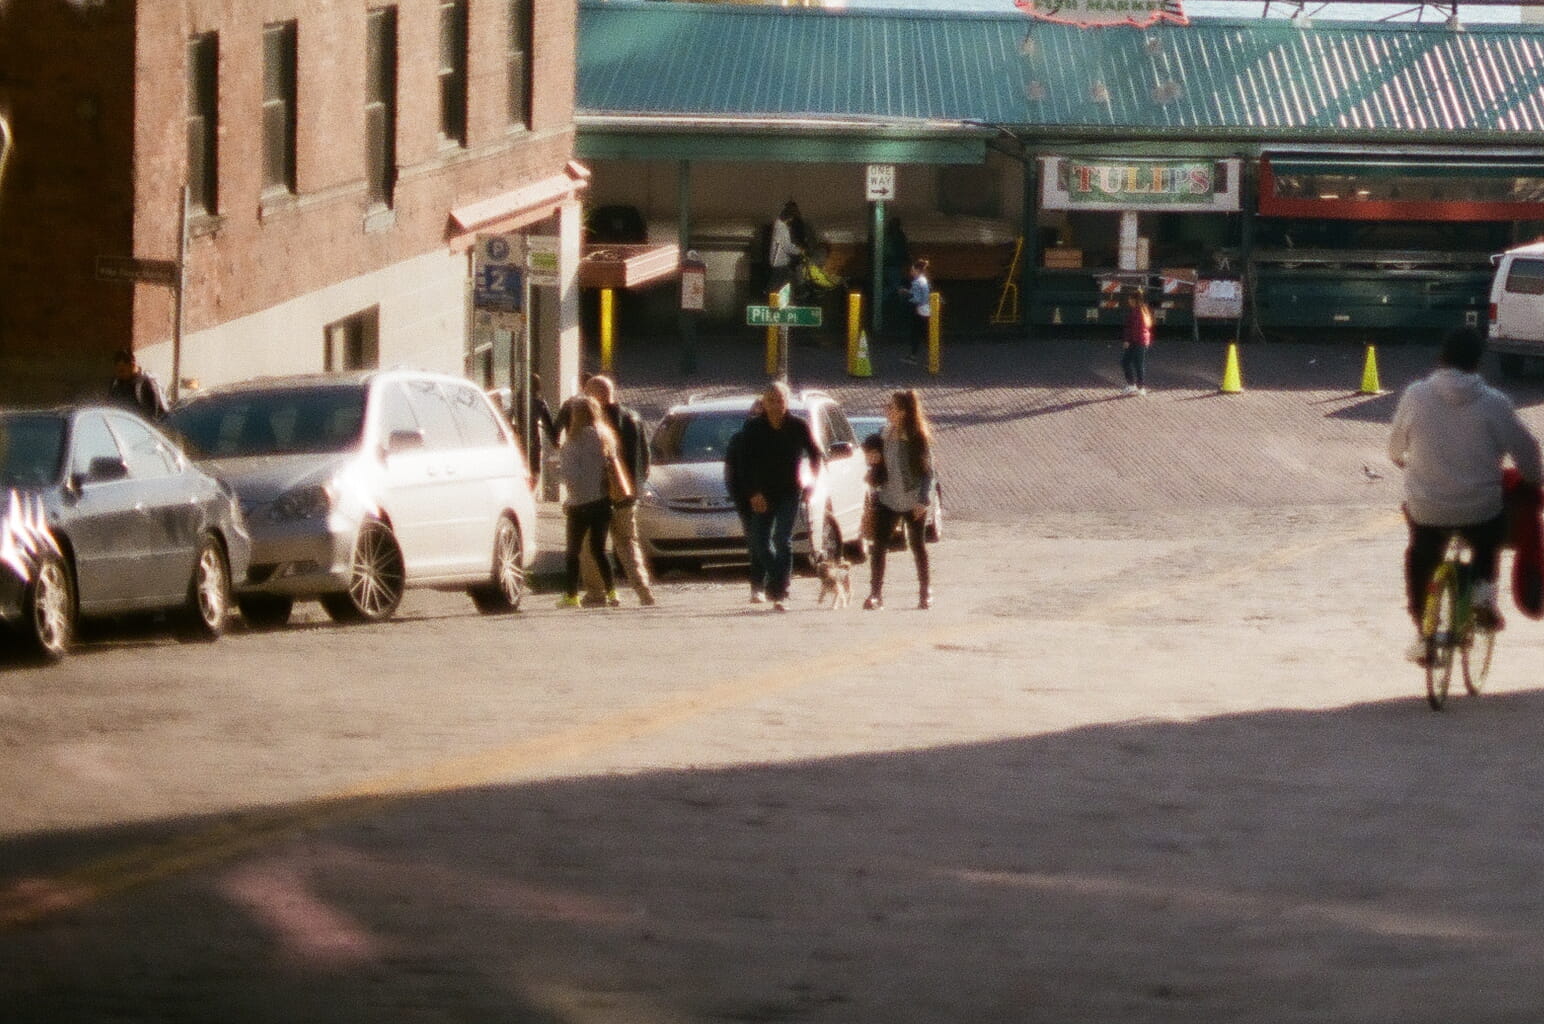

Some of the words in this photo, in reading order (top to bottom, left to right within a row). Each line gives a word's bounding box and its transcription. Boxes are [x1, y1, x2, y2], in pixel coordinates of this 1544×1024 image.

[871, 166, 892, 176] ONE
[871, 176, 892, 185] WAY
[1073, 165, 1210, 194] TULIPS
[752, 308, 781, 323] Pike
